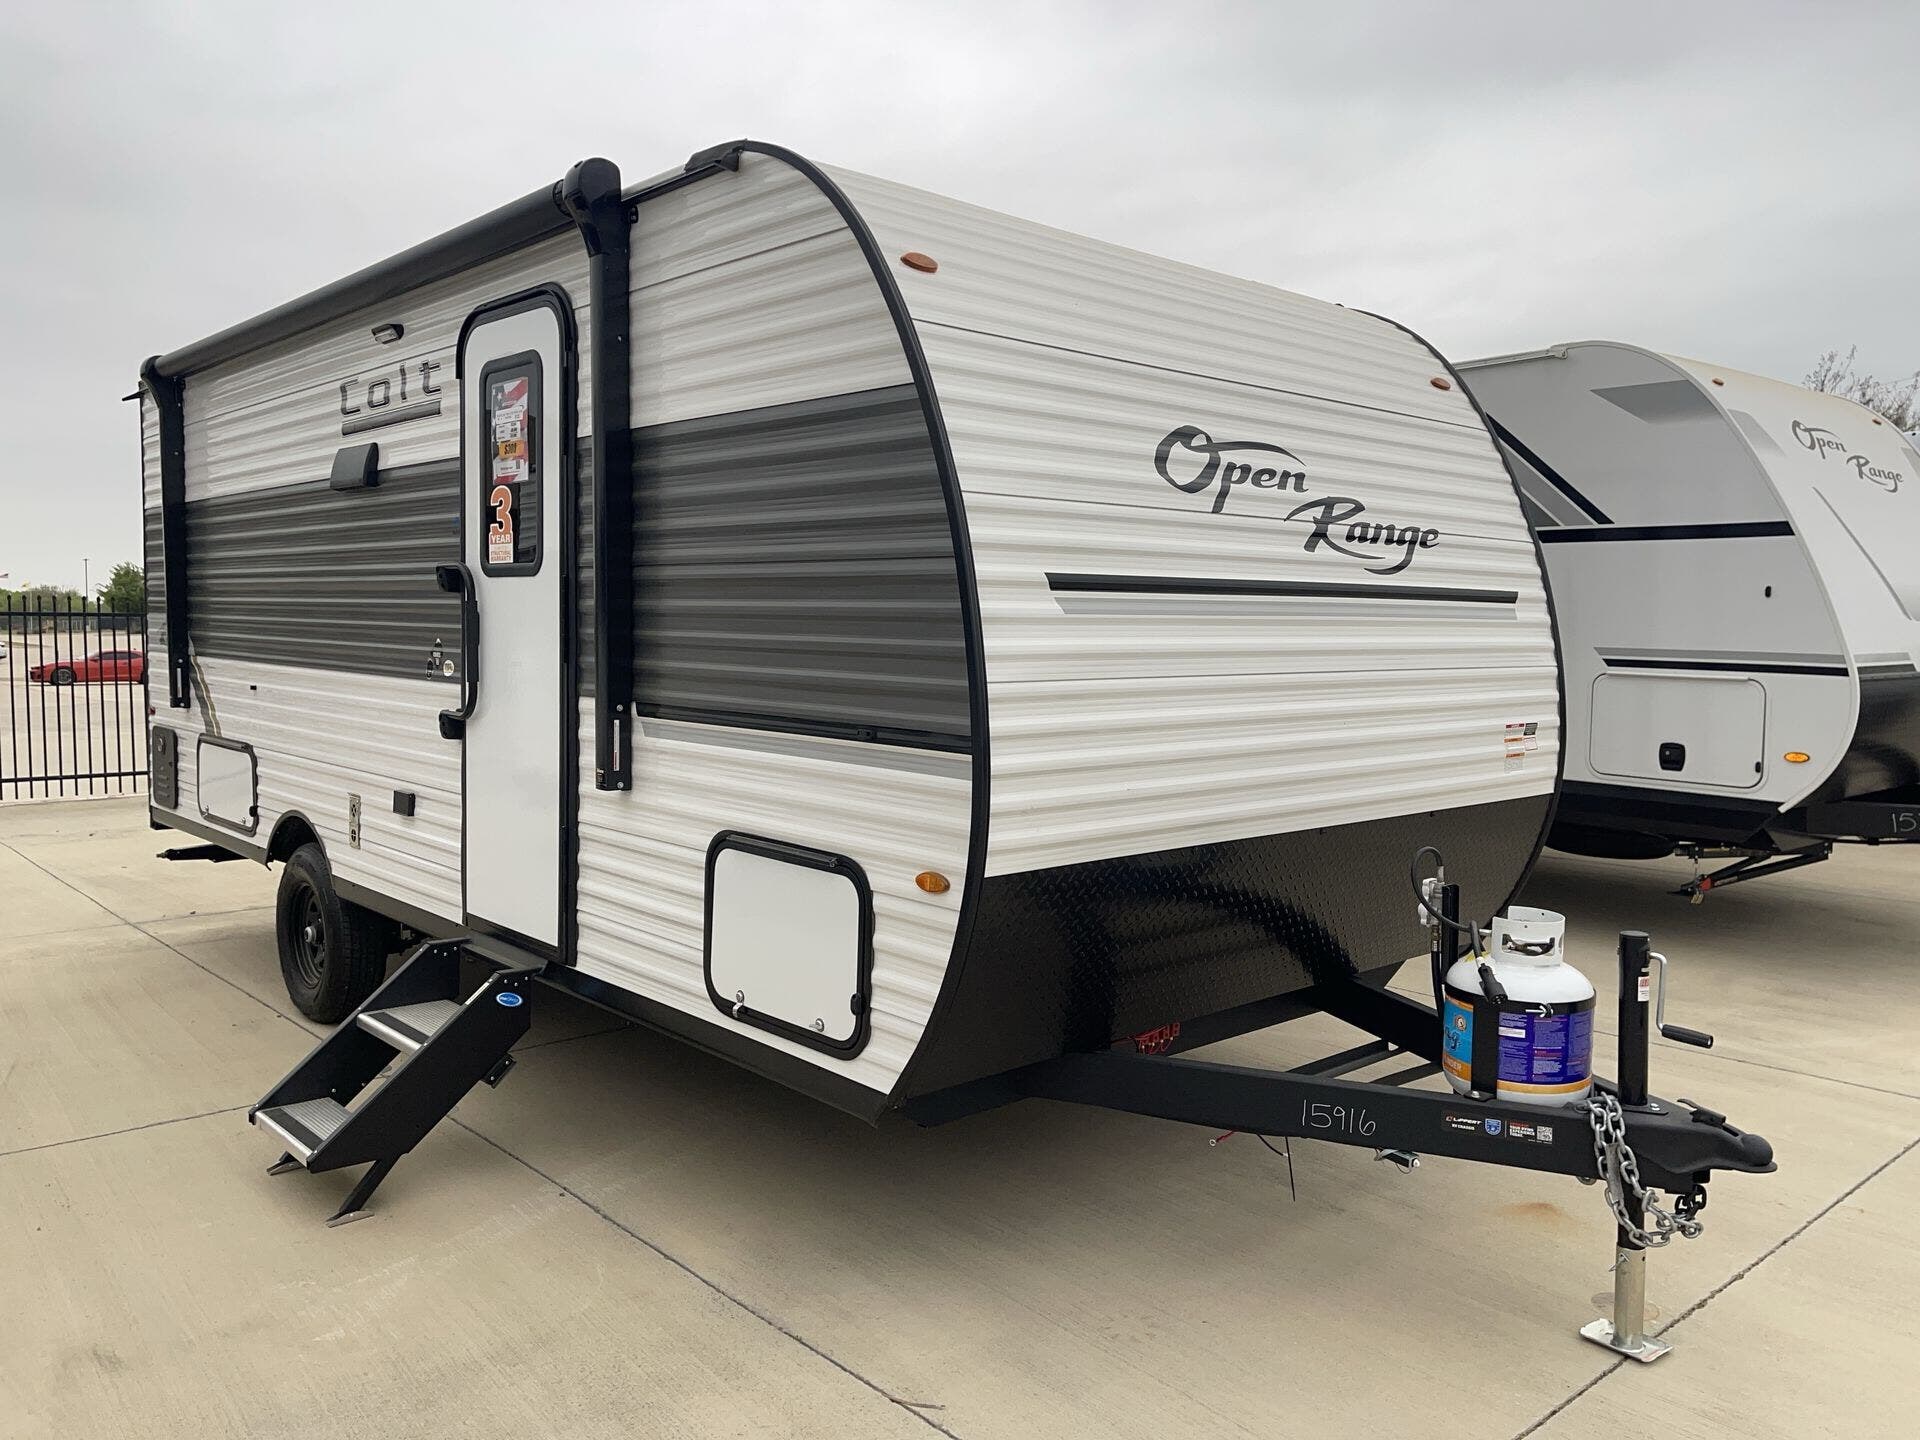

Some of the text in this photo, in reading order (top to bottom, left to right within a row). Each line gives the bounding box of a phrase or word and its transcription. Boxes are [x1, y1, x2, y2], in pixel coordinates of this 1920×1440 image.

[340, 361, 441, 416] Colt
[1792, 419, 1847, 459] Open
[1154, 424, 1309, 514] Open
[1846, 455, 1904, 493] Range
[490, 485, 513, 534] 3
[491, 533, 511, 544] YEAR
[1284, 496, 1440, 576] Range
[1892, 812, 1920, 833] 15
[1302, 1099, 1376, 1136] 15916
